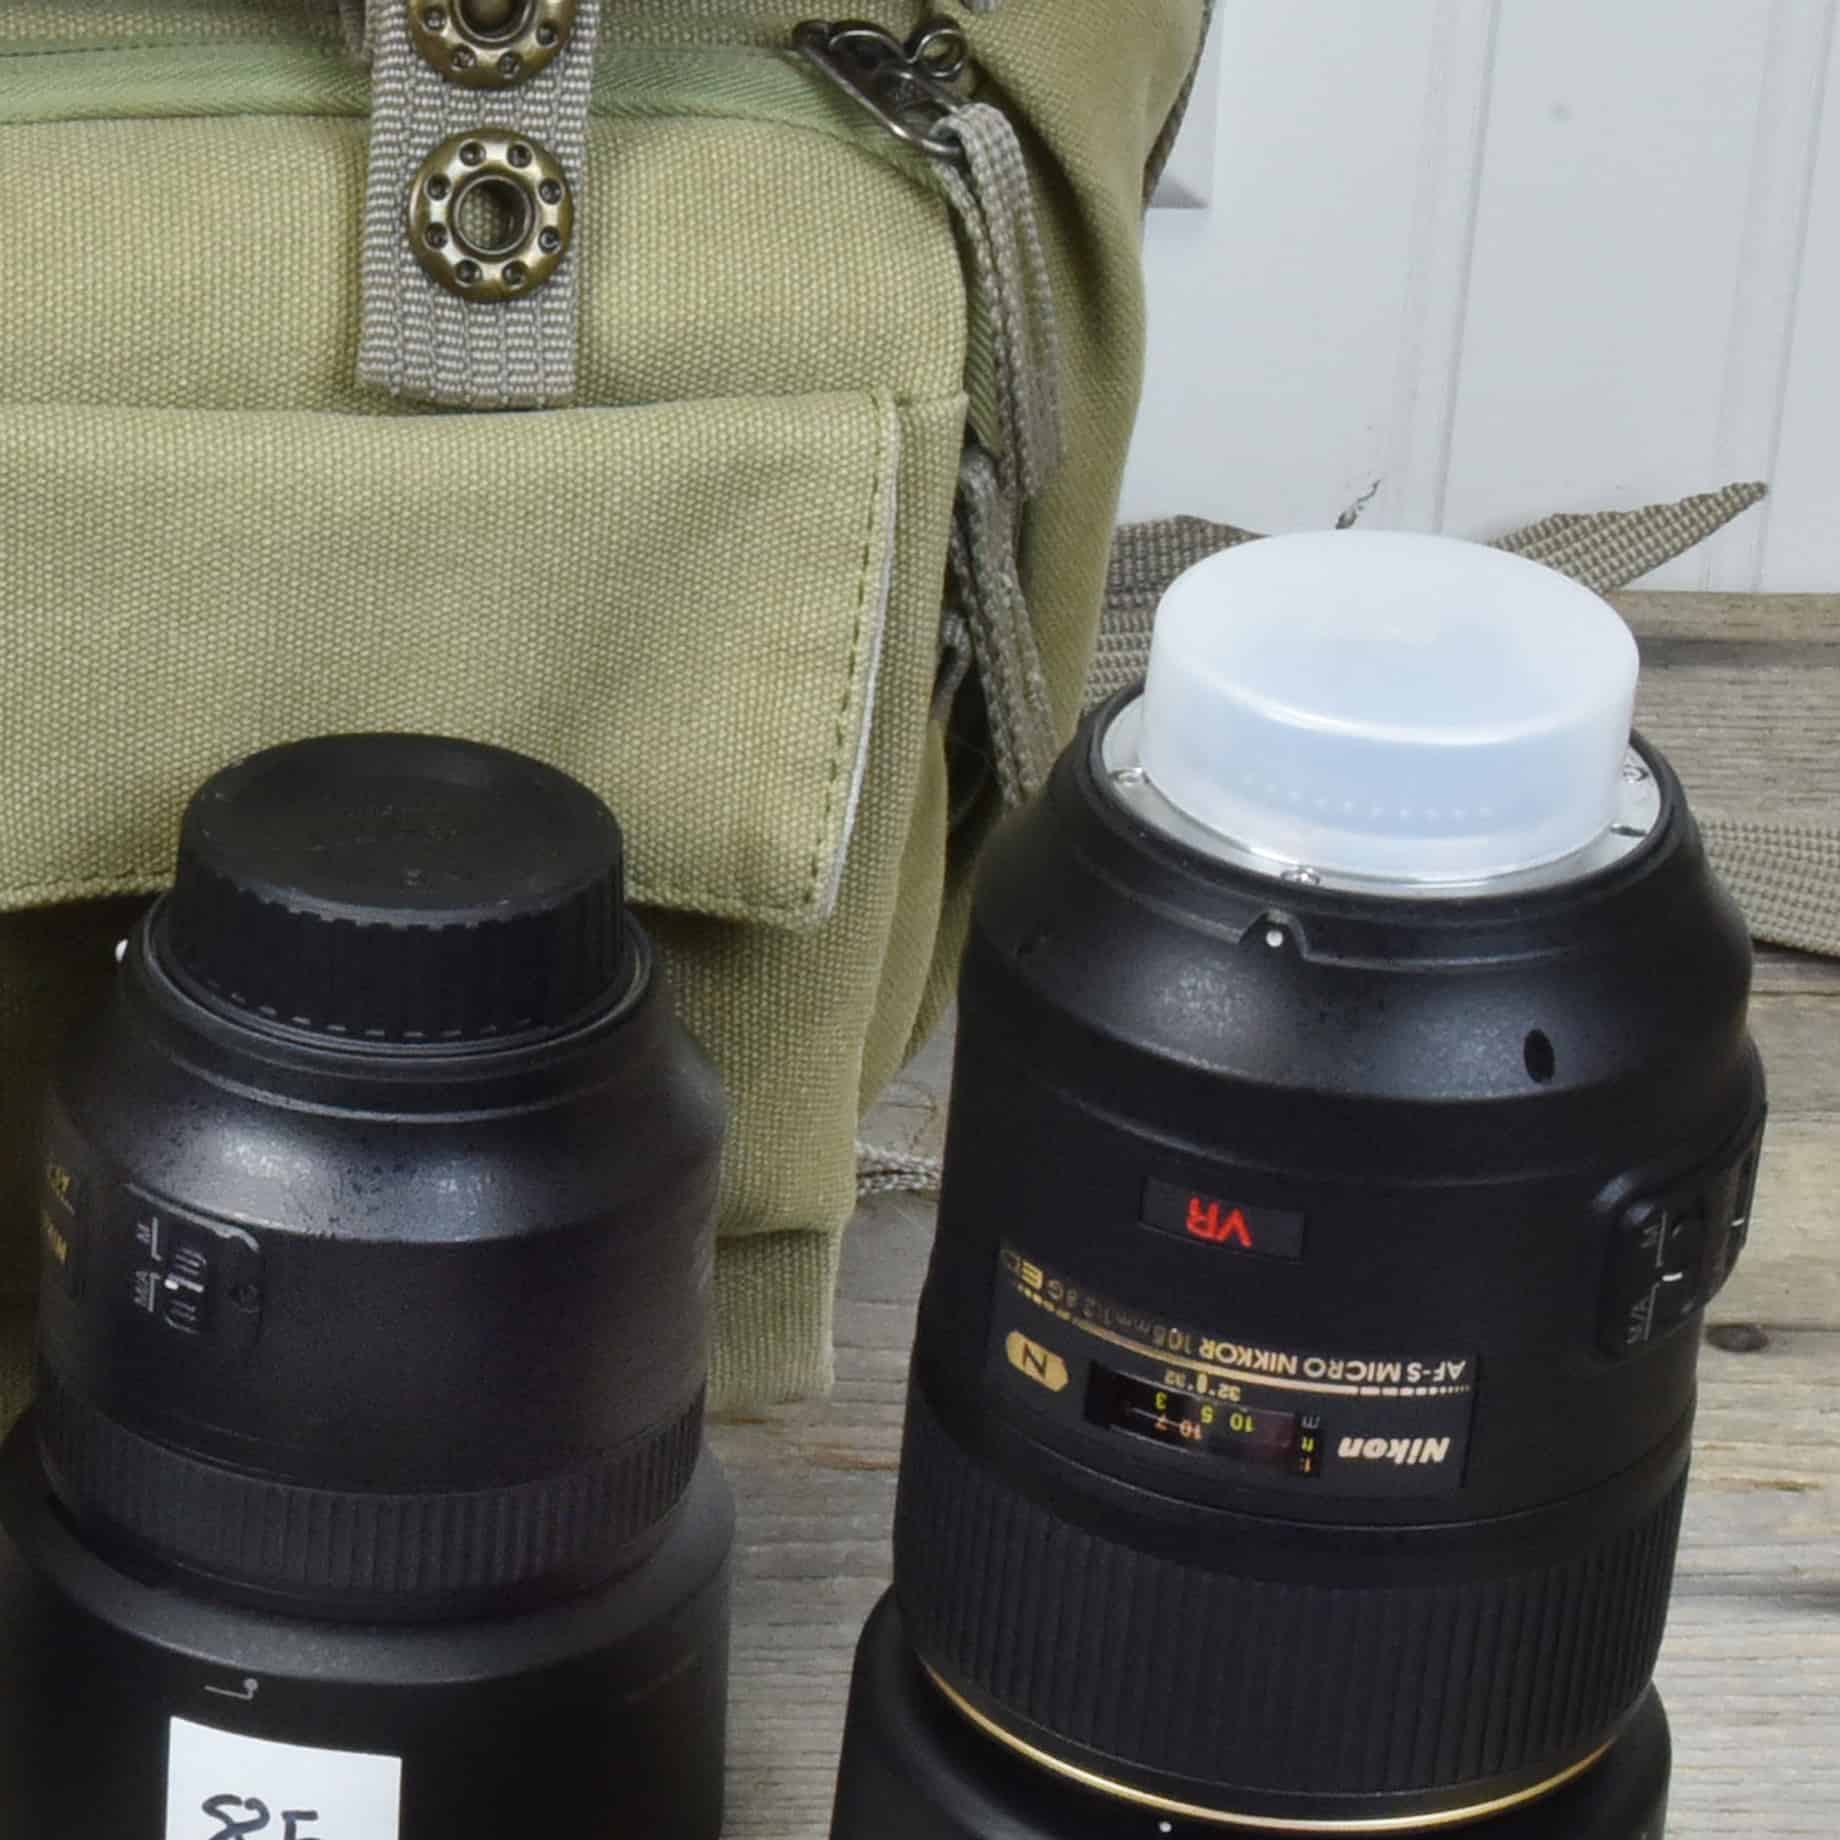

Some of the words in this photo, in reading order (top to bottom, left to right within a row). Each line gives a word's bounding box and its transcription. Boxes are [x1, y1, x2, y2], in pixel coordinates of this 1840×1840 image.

[1186, 1195, 1252, 1249] VR
[1198, 1337, 1299, 1377] NIKKOR
[1306, 1357, 1402, 1382] MICRO
[1408, 1360, 1466, 1381] AF-S
[1229, 1411, 1254, 1433] 10
[1337, 1435, 1452, 1466] Nikon
